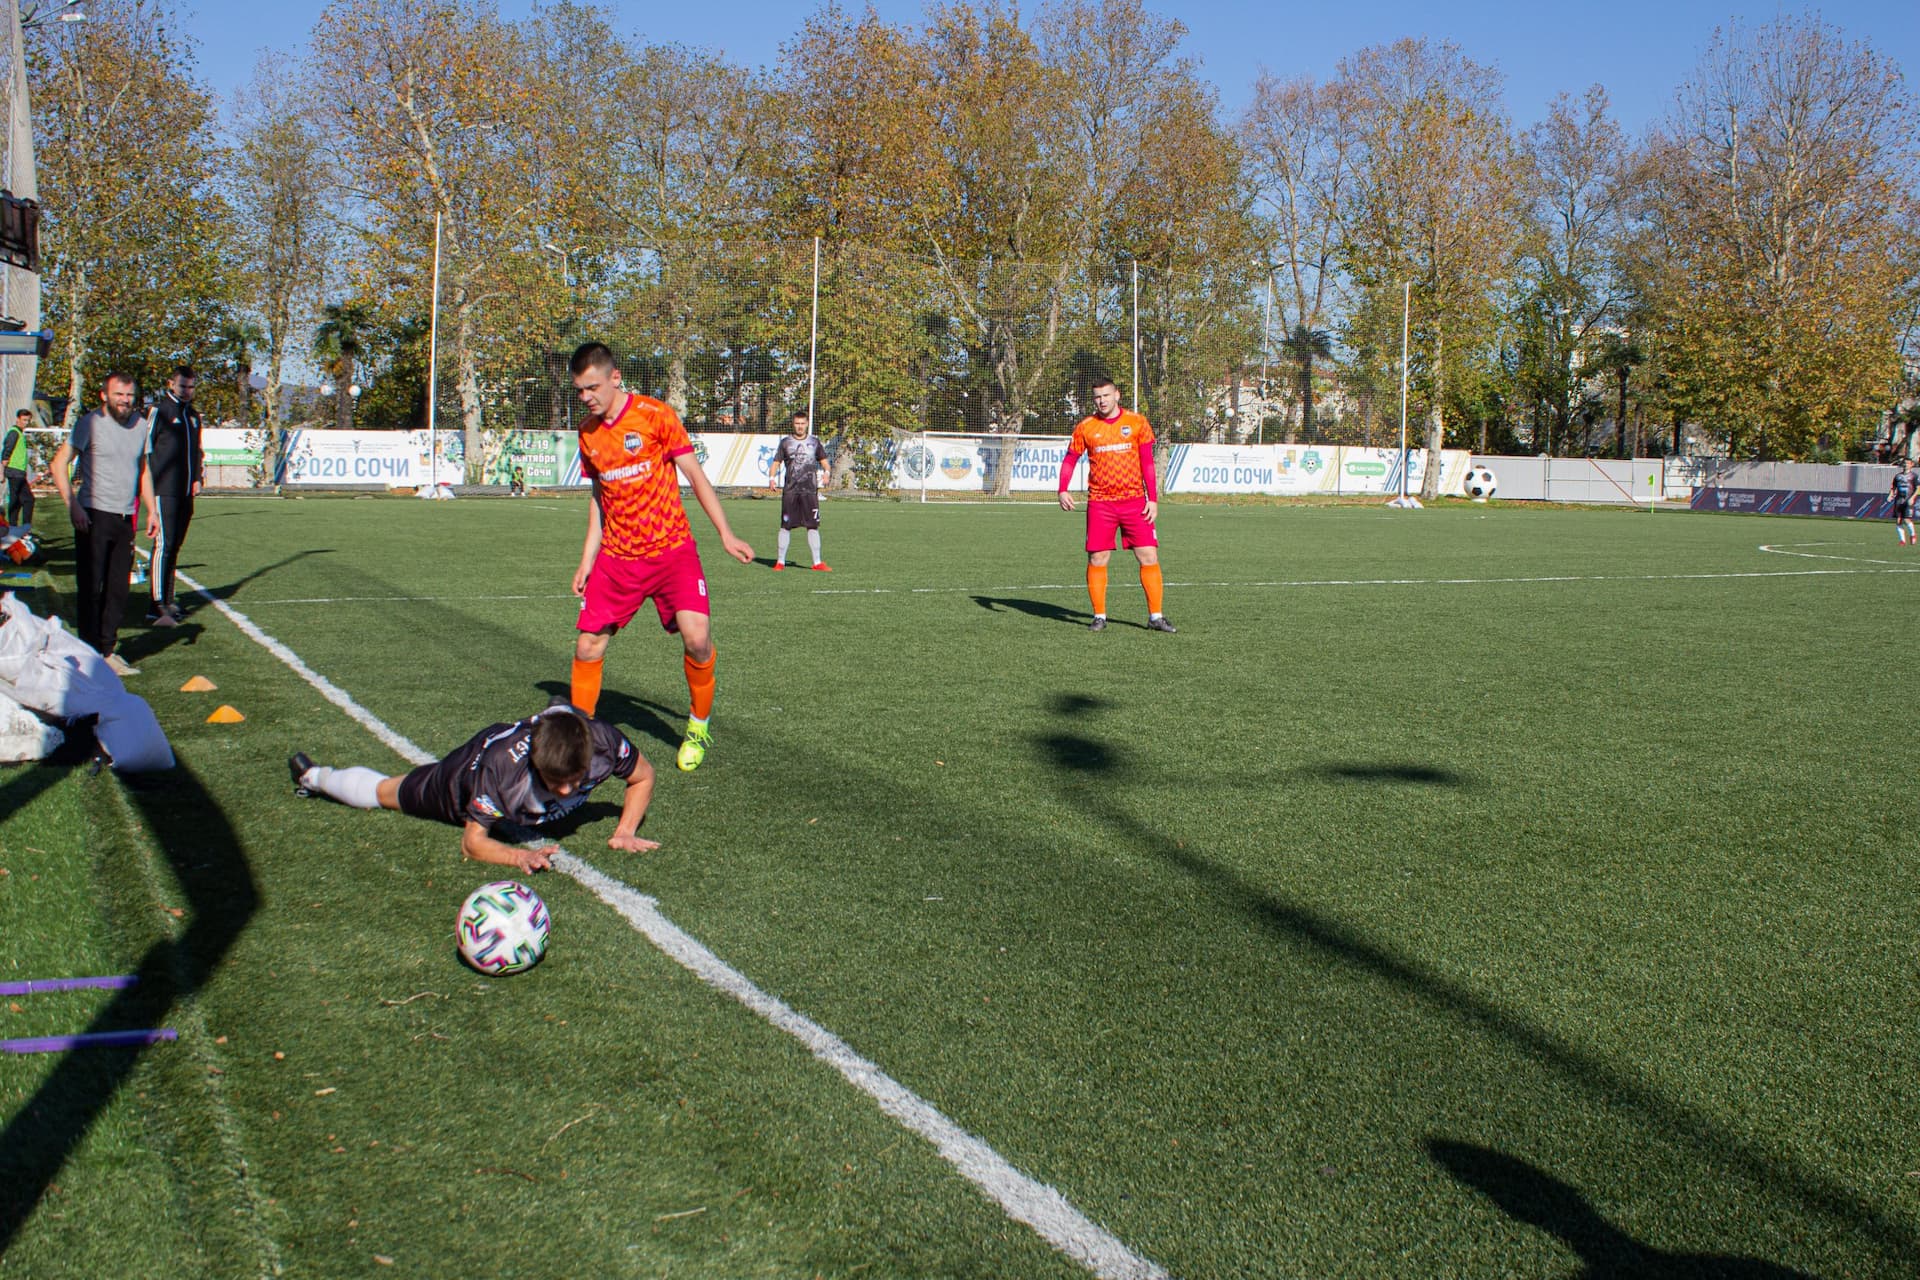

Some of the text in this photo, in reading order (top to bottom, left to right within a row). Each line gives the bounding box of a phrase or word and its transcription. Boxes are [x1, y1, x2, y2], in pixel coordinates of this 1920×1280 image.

[293, 457, 347, 478] 2020
[354, 457, 409, 478] СОЧИ
[527, 466, 552, 477] Сочи
[1013, 464, 1058, 481] КОРДА
[1192, 466, 1273, 485] 2020 СОЧИ
